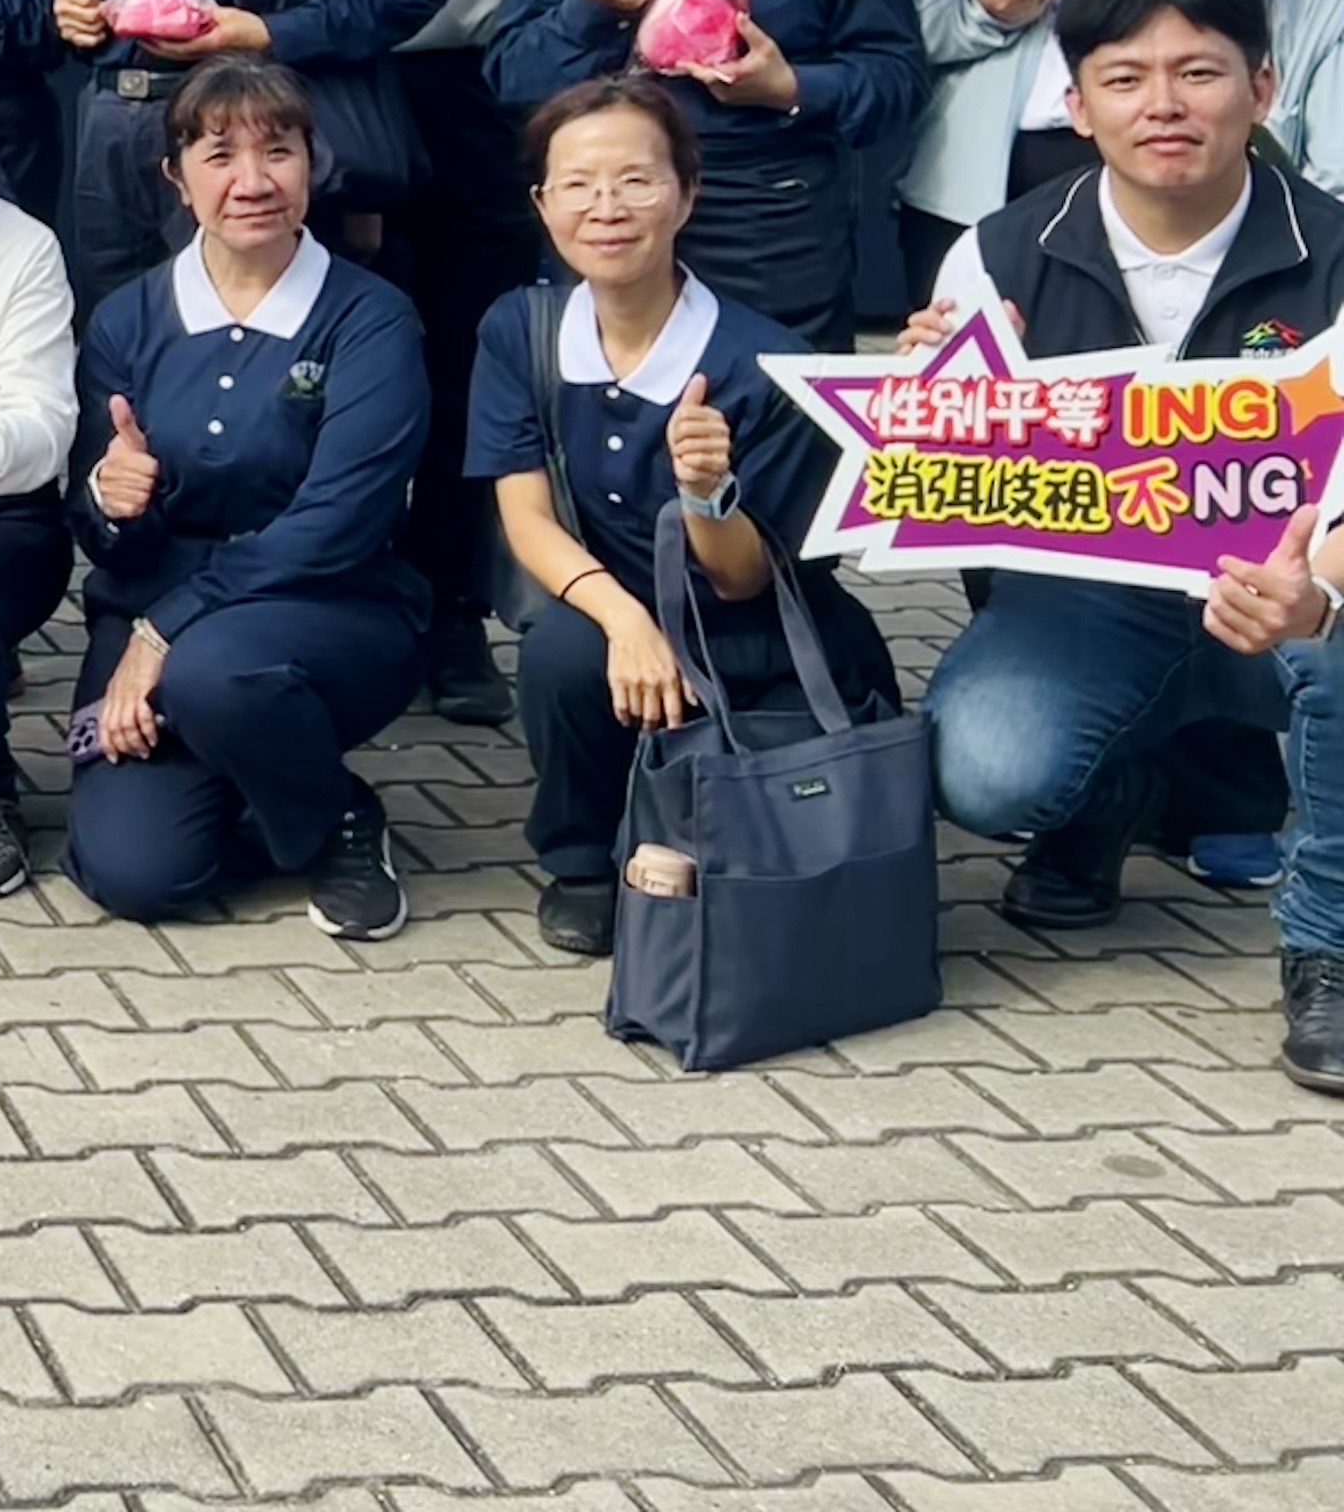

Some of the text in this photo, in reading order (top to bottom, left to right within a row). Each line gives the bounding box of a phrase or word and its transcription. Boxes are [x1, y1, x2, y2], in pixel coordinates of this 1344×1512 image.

[871, 374, 1278, 448] 性別平等 ING
